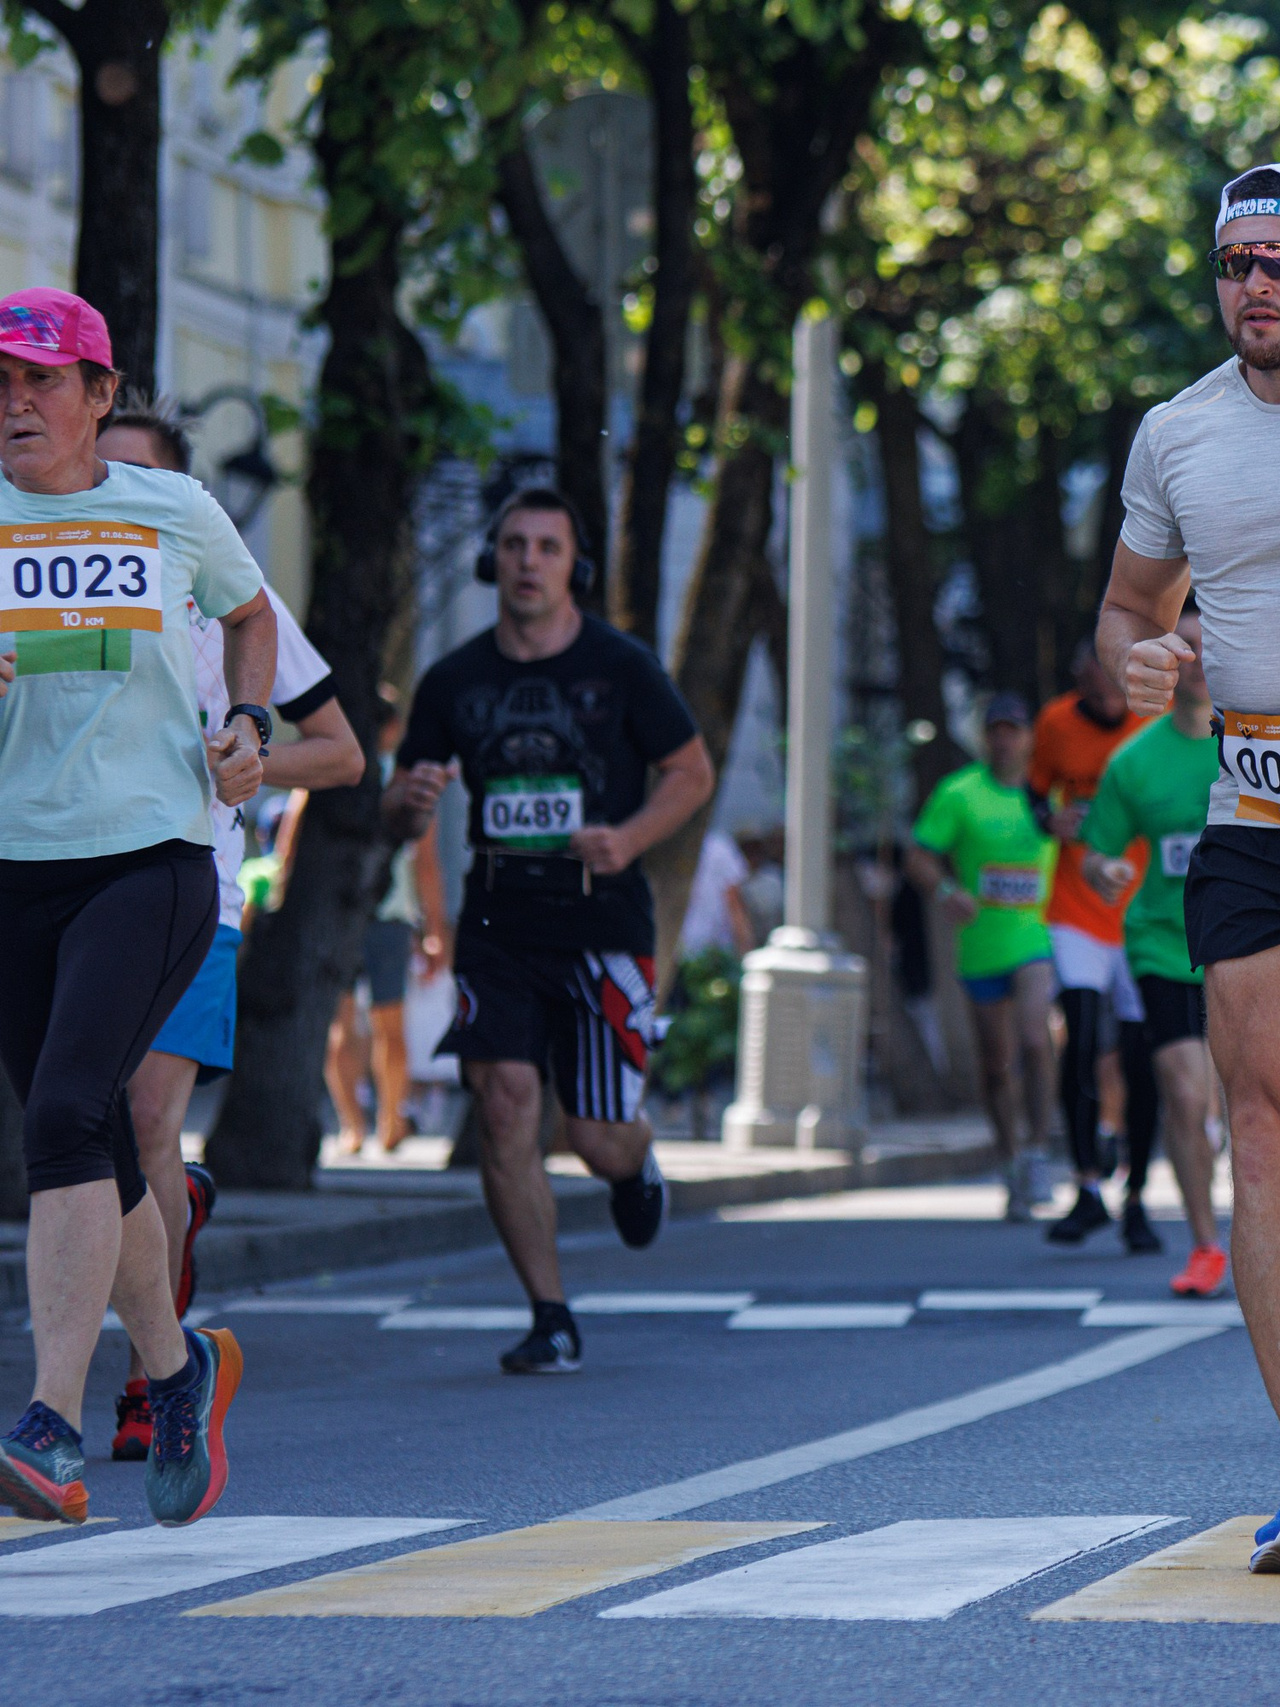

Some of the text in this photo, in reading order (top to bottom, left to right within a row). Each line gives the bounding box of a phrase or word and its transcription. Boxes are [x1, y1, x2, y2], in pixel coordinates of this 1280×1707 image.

[100, 531, 144, 541] 01.06.2024
[13, 554, 148, 599] 0023
[60, 611, 82, 627] 10
[492, 798, 571, 829] 0489
